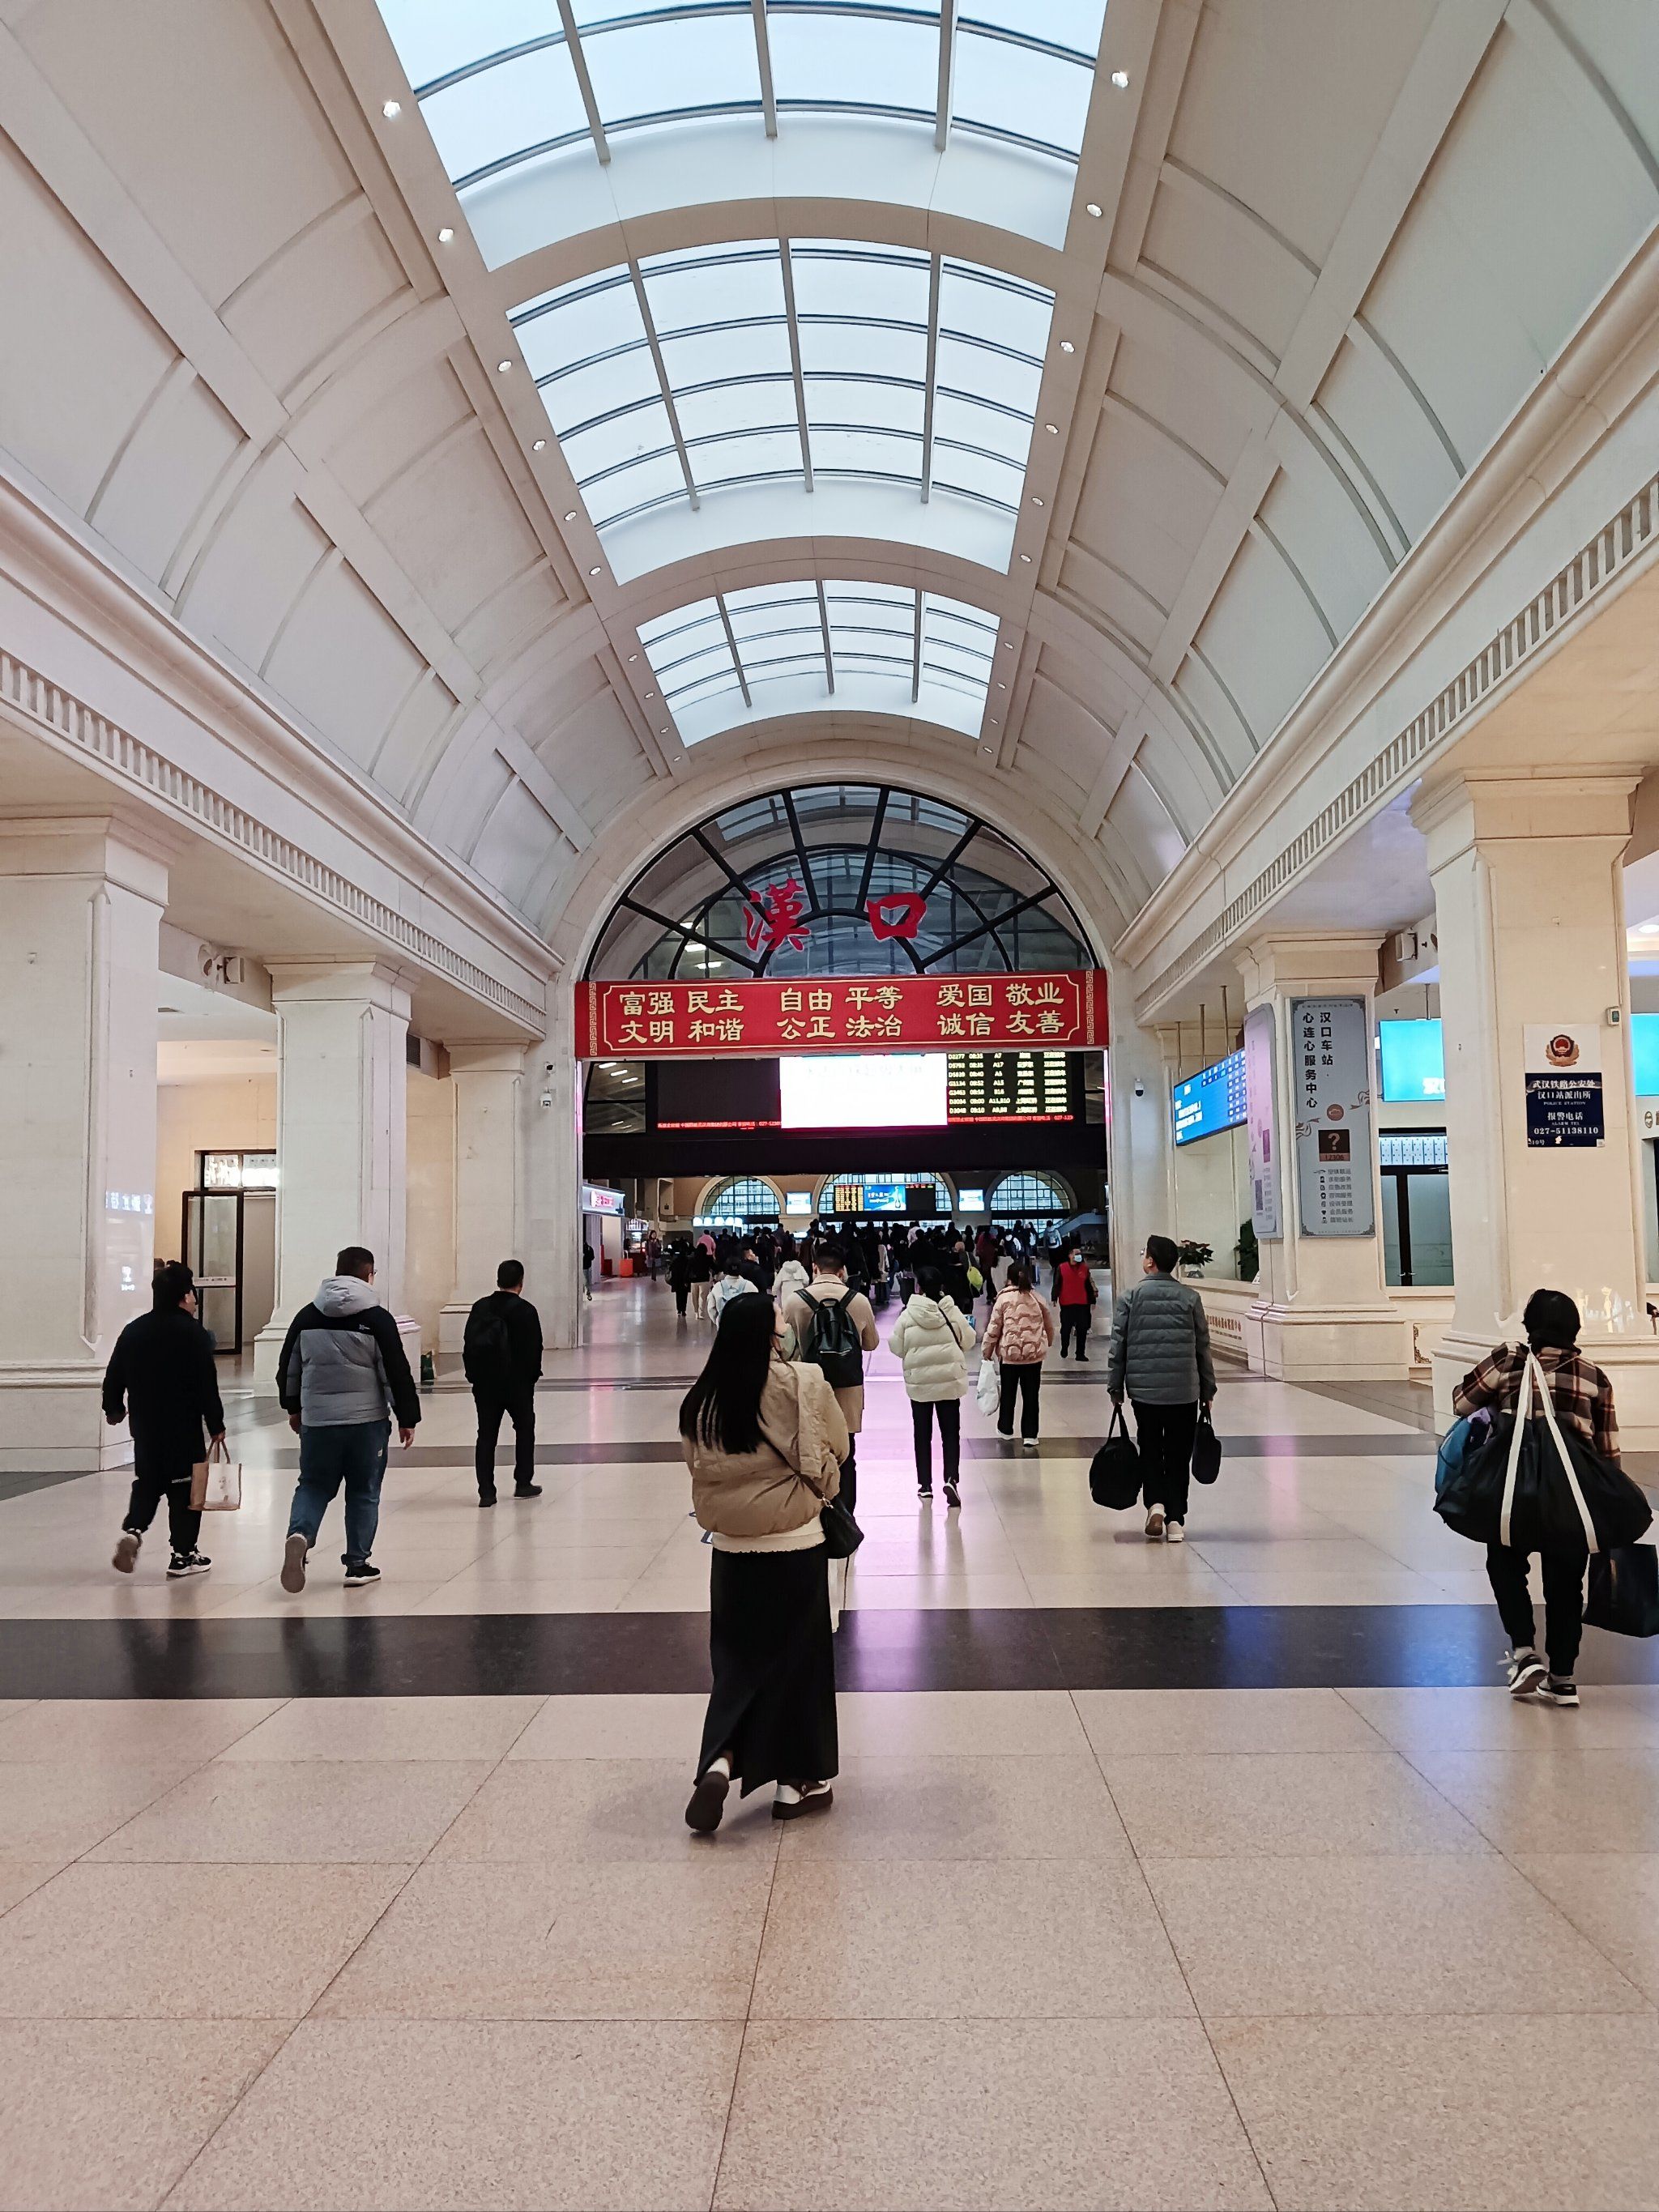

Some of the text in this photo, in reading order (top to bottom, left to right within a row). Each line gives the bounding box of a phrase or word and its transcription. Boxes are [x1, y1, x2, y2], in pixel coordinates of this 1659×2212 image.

[619, 982, 1064, 1016] 富强 民主 自由 平等 爱国 敬业
[618, 1010, 1064, 1043] 文明 和谐 公正 法治 诚信 友善
[1320, 1012, 1333, 1066] 汉口车站
[1303, 1012, 1318, 1108] 心连心服务中心
[1533, 1080, 1595, 1089] 武汉铁路公安处
[1537, 1091, 1591, 1099] 汉口站派出所
[1547, 1112, 1583, 1120] 报警电话
